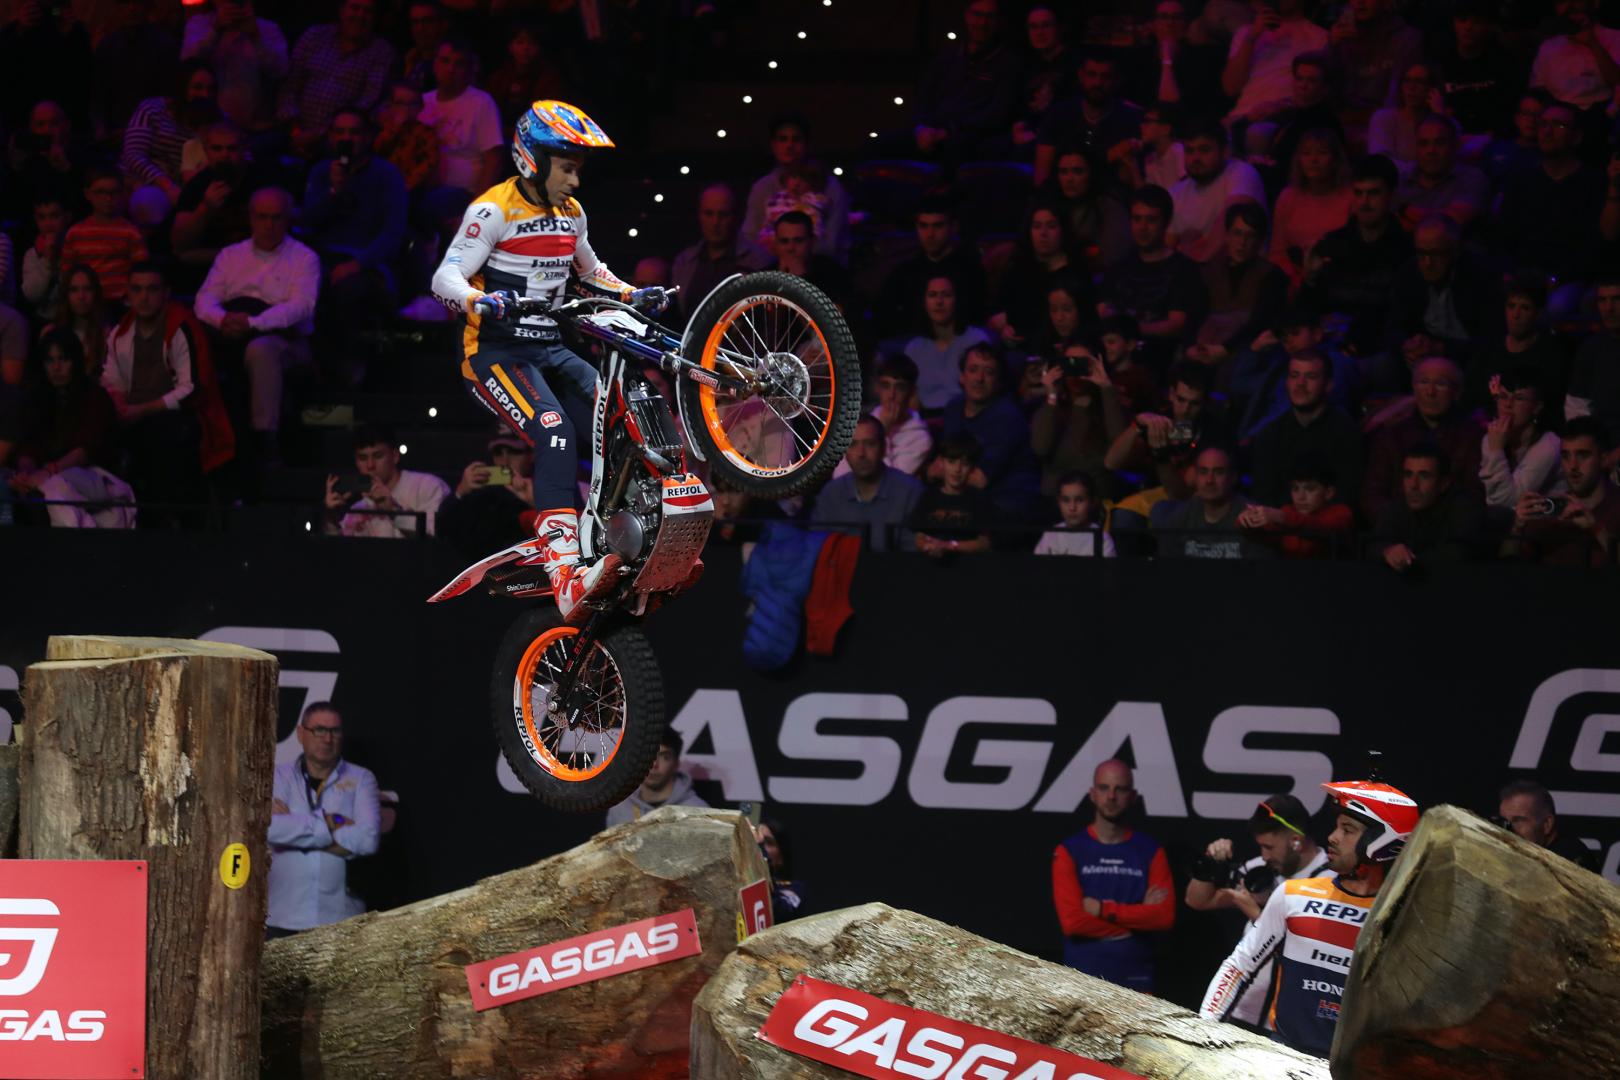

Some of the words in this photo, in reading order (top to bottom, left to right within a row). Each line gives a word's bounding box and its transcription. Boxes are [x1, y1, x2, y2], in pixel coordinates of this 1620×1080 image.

[485, 377, 526, 430] REPSOL
[595, 384, 608, 457] REPSOL
[667, 486, 702, 496] REPSOL
[514, 706, 537, 756] REPSOL
[497, 687, 1341, 820] ASGAS
[232, 854, 242, 877] F
[1303, 900, 1369, 923] REPS
[489, 922, 679, 997] GASGAS
[1311, 949, 1351, 968] heb
[1302, 979, 1345, 996] HON
